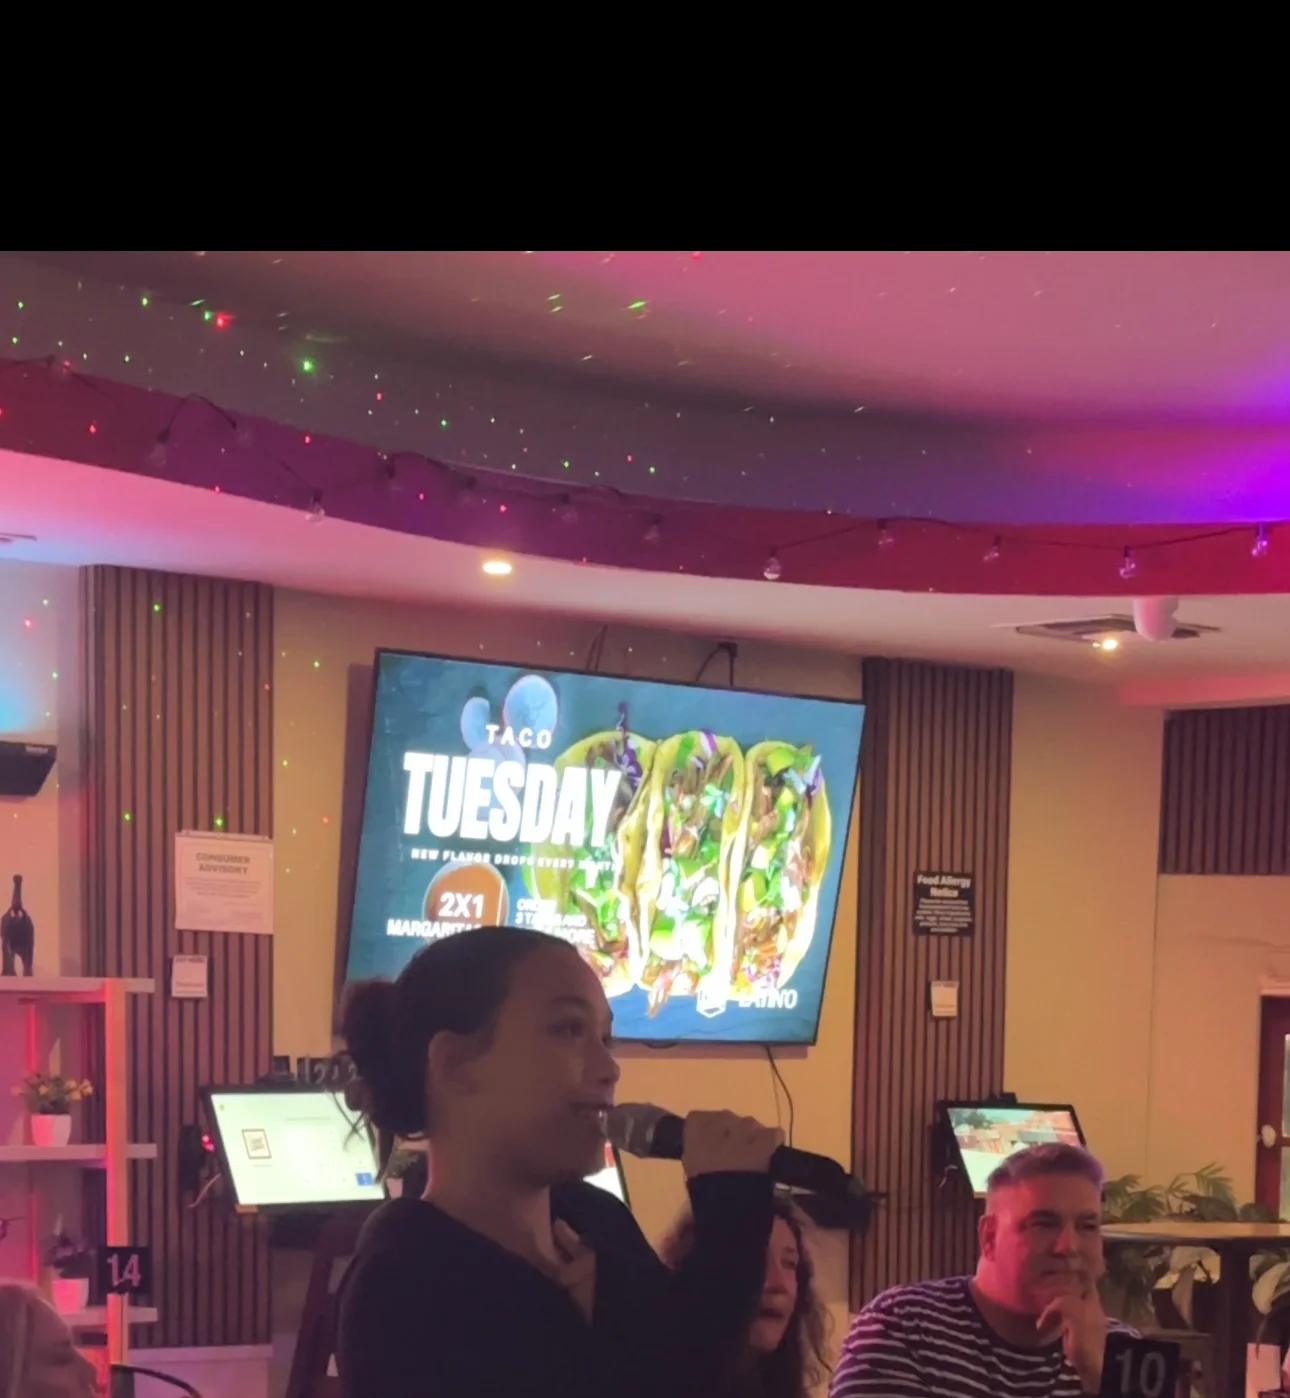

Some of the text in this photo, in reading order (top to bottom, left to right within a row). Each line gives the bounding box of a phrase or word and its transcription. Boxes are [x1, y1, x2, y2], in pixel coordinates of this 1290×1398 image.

[485, 724, 551, 750] TACO
[403, 751, 621, 847] TUESDAY
[196, 852, 251, 864] CONSUMER
[198, 863, 249, 874] ADVISORY
[411, 848, 439, 860] NEW
[442, 850, 490, 864] FLAVOR
[494, 854, 534, 867] DROPS
[917, 874, 972, 888] Food Allergy
[930, 886, 959, 898] Notice
[438, 892, 485, 918] 2X1
[106, 1253, 142, 1288] 14
[1115, 1348, 1166, 1398] 10
